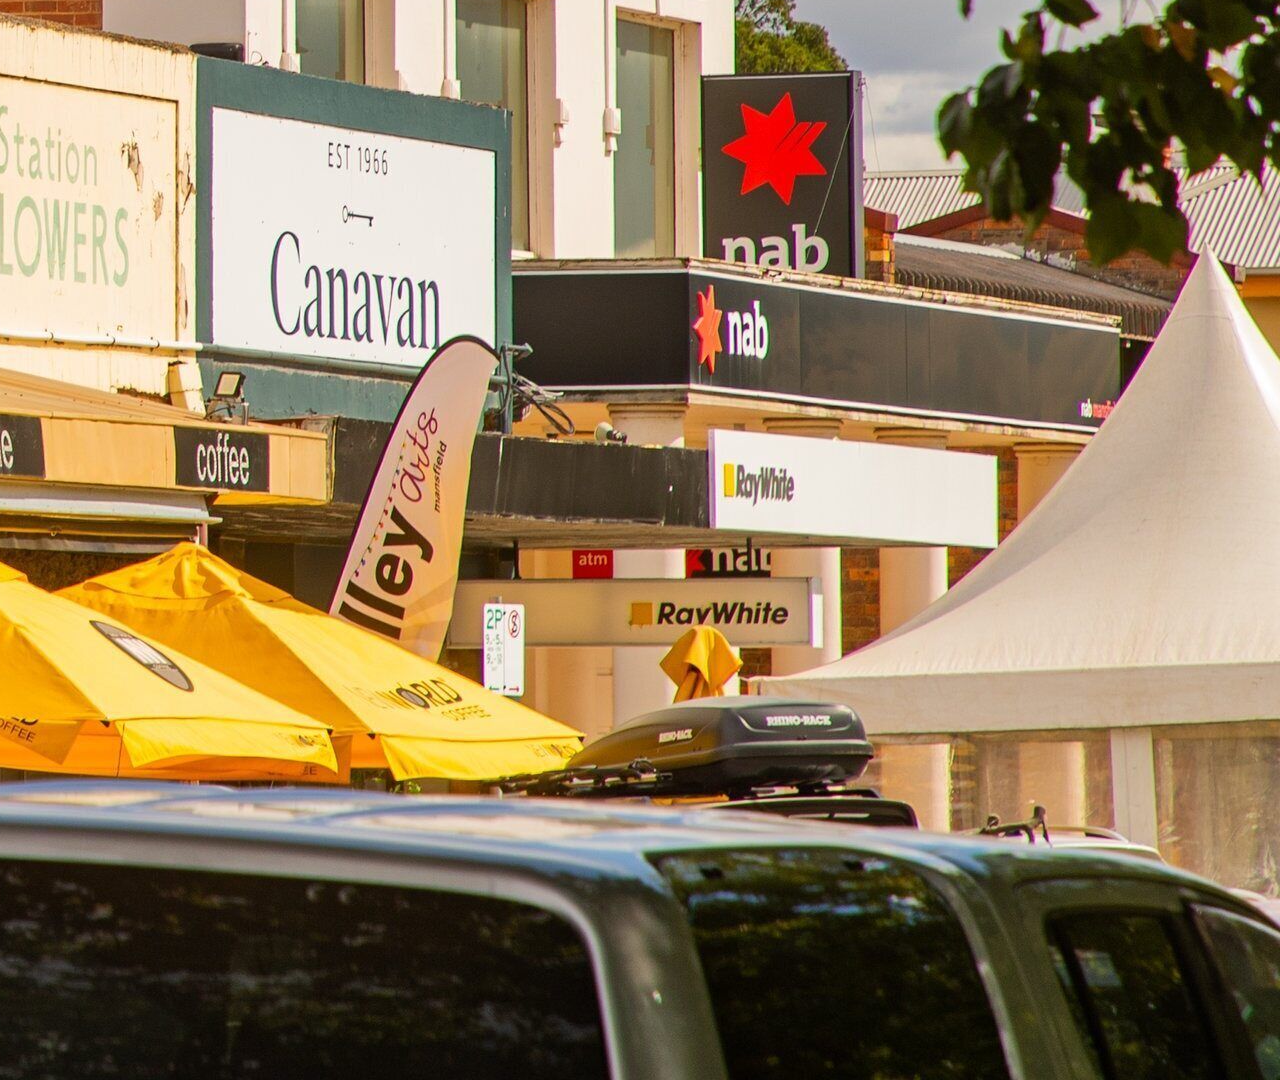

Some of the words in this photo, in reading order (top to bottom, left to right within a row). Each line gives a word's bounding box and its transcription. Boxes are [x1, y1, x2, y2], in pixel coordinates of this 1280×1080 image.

[327, 142, 351, 171] EST
[357, 145, 389, 176] 1966
[721, 224, 830, 274] nab
[270, 231, 441, 352] Canavan
[727, 300, 770, 360] nab
[196, 432, 250, 487] coffee
[434, 441, 448, 514] mansfield
[339, 505, 434, 640] lley
[400, 408, 439, 503] arts
[578, 552, 608, 566] atm
[765, 715, 832, 726] RHINO-RACK
